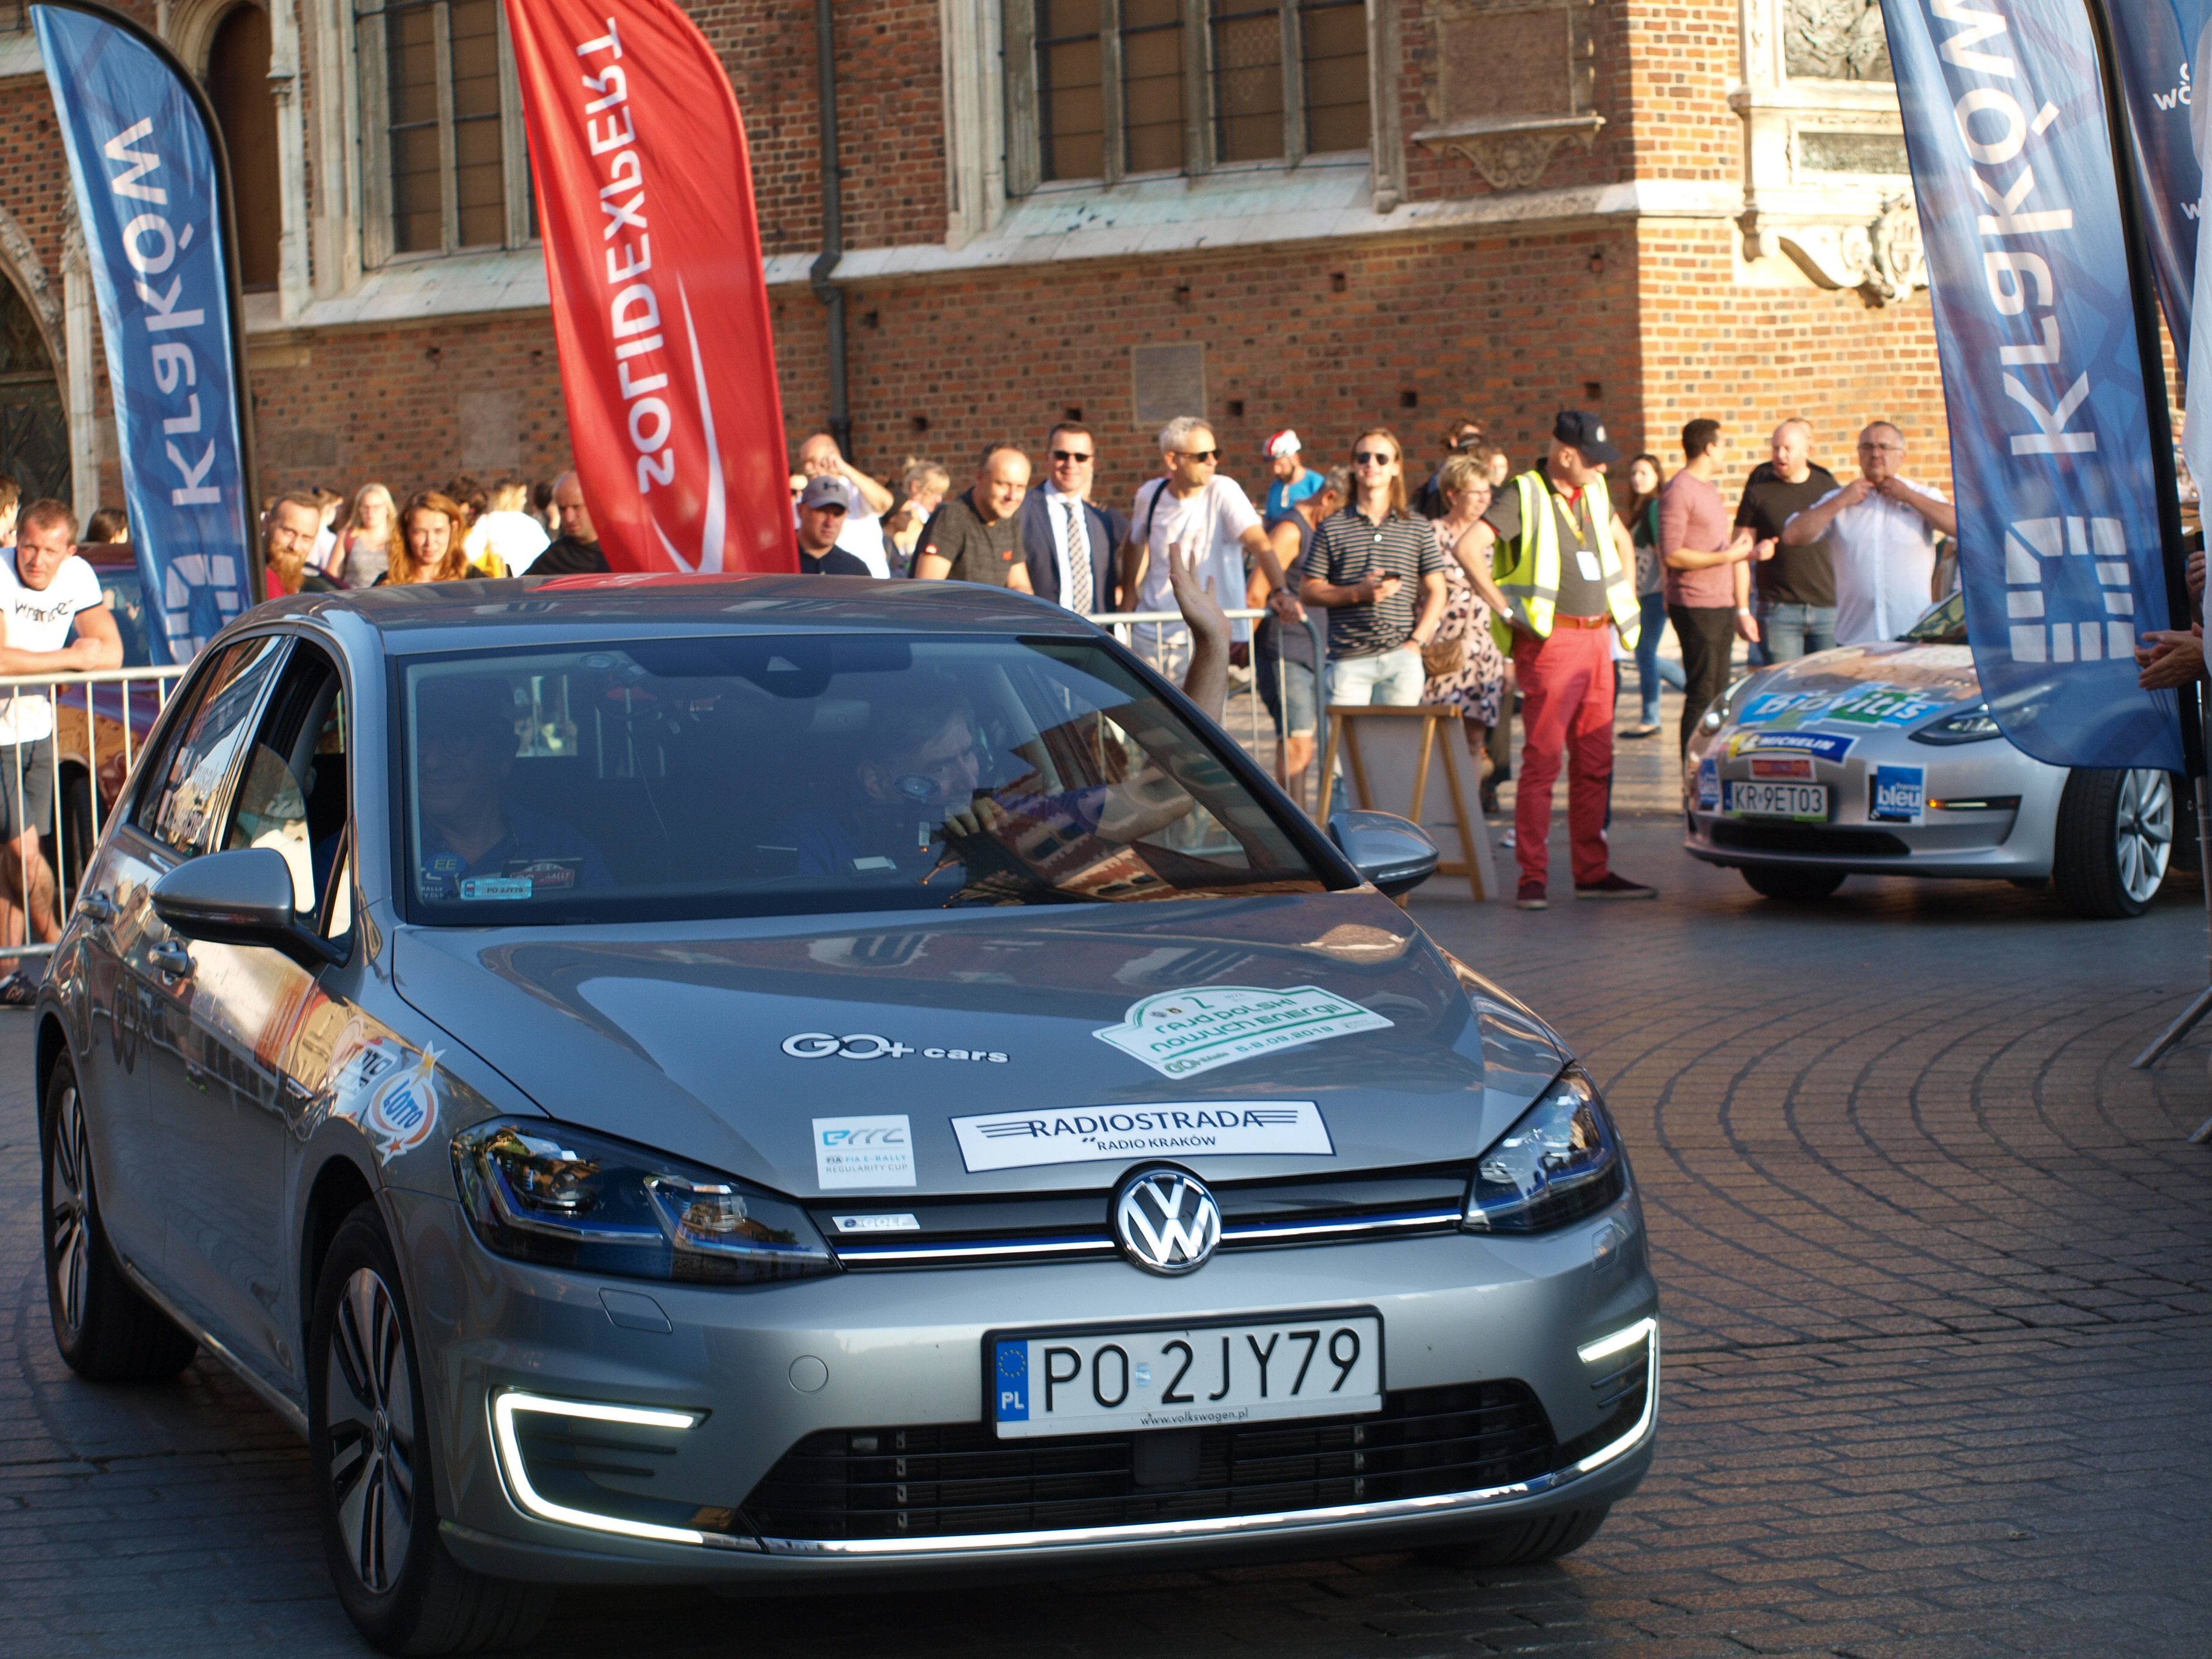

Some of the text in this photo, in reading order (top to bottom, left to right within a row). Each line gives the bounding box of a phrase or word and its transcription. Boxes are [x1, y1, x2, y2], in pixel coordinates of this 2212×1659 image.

[1759, 734, 1836, 751] MICHELIN
[1735, 785, 1757, 809] KR
[1765, 786, 1823, 813] 9ET03
[1877, 785, 1921, 808] bleu
[434, 858, 458, 871] EE
[1180, 996, 1215, 1009] 2
[923, 1047, 1010, 1064] cars
[1028, 1110, 1264, 1138] RADIOSTRADA
[1097, 1134, 1217, 1151] RADIO KRAKÓW
[826, 1164, 885, 1173] REGULARITY
[1045, 1327, 1361, 1413] PO 2JY79
[1000, 1390, 1025, 1410] PL
[1139, 1407, 1249, 1427] www.volkswagen.pl
